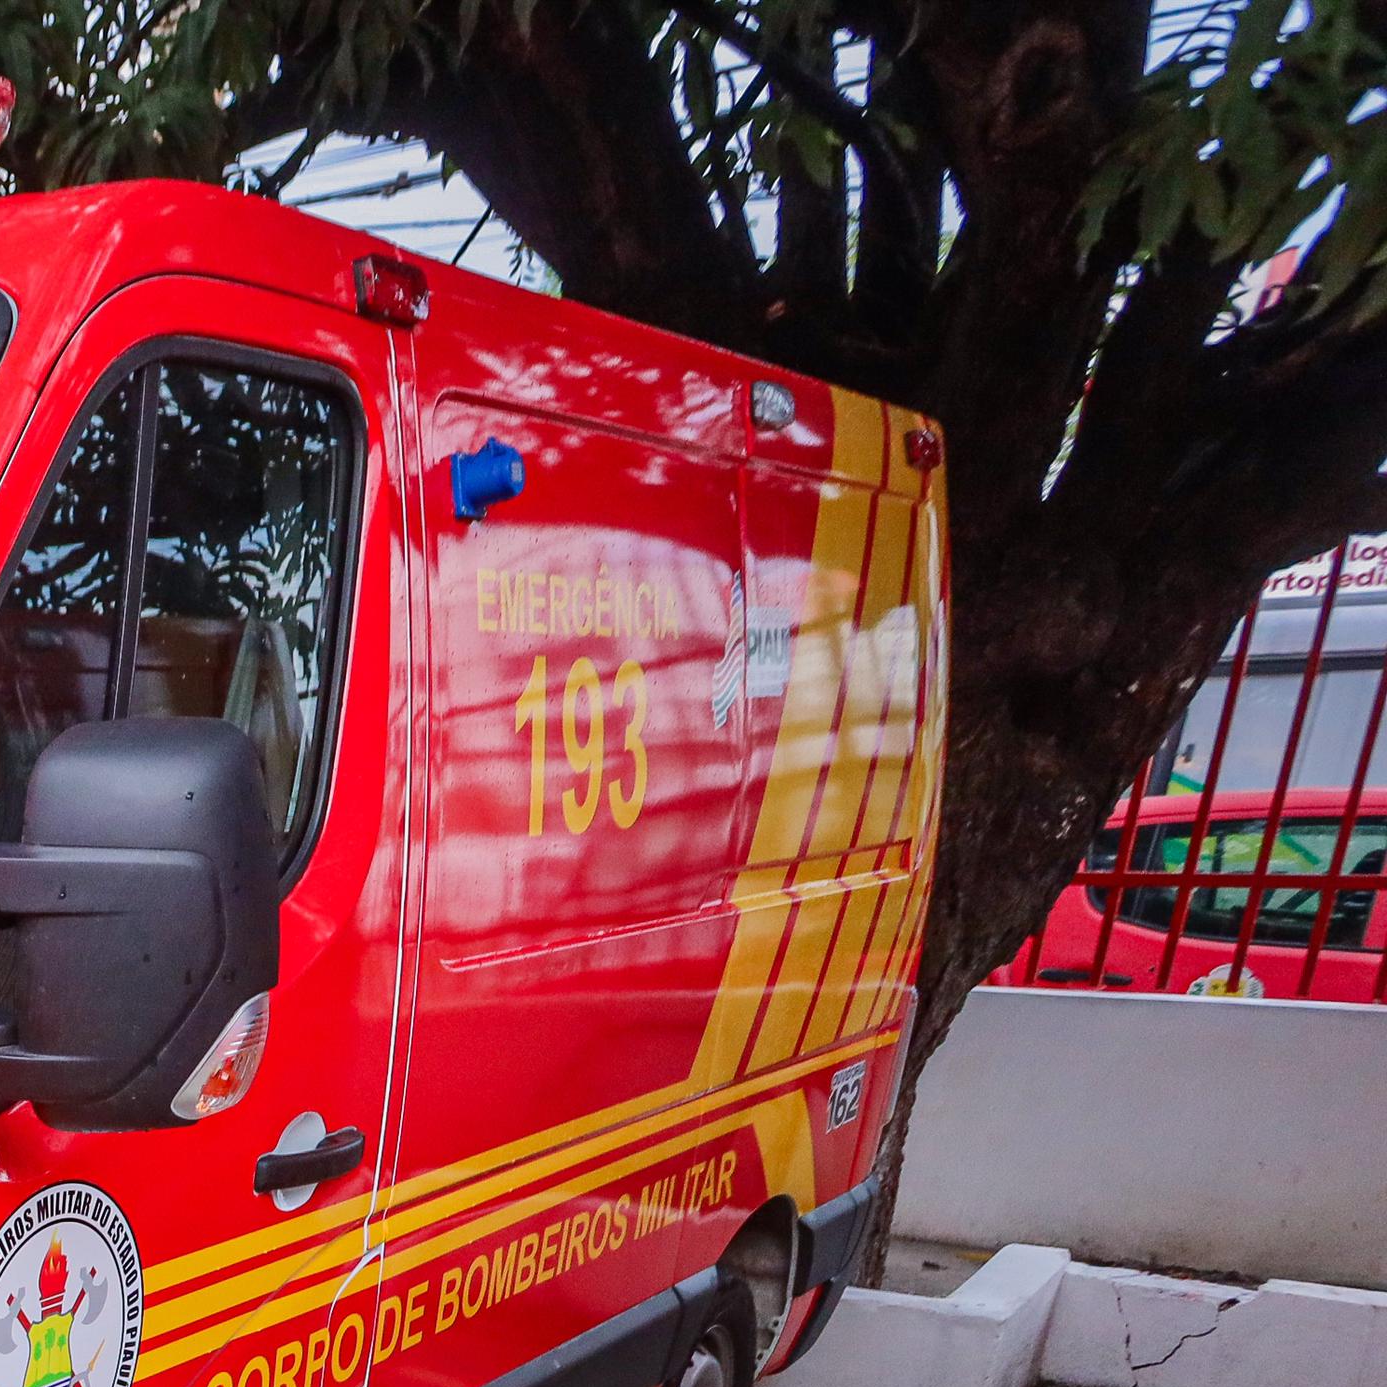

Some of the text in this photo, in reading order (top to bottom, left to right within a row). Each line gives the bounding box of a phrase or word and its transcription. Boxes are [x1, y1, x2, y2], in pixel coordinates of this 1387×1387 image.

[477, 563, 680, 640] EMERGÊNCIA
[515, 656, 648, 837] 193
[827, 1078, 860, 1130] 162
[36, 1189, 93, 1224] MILITAR
[91, 1197, 110, 1225] DO
[108, 1215, 139, 1290] ESTADO
[126, 1289, 140, 1322] DO
[372, 1280, 429, 1366] DE
[434, 1193, 631, 1335] BOMBEIROS
[633, 1150, 738, 1240] MILITAR
